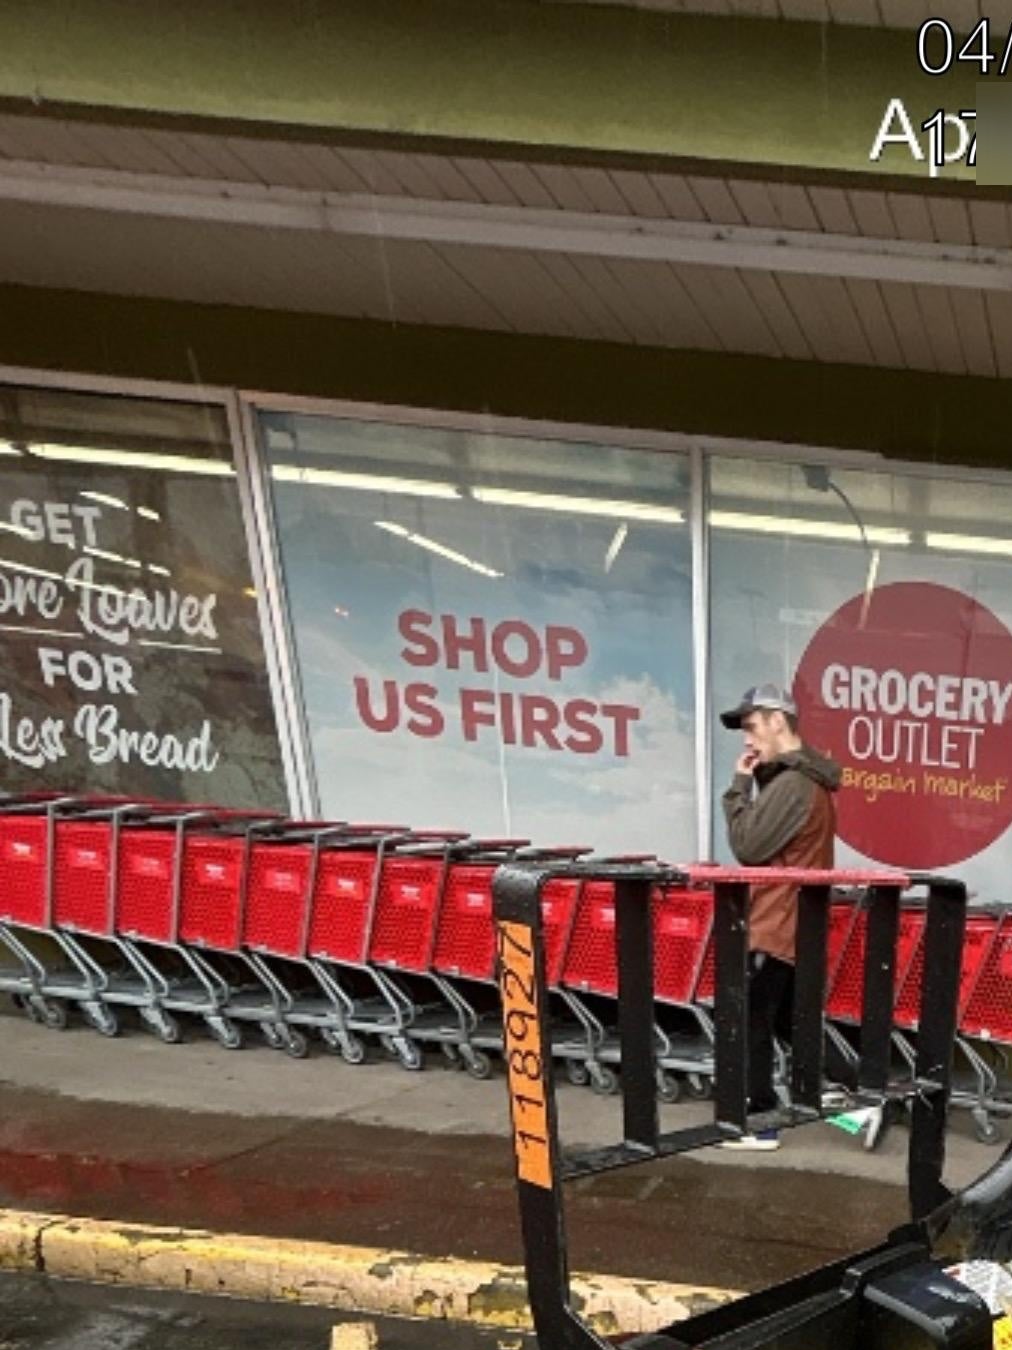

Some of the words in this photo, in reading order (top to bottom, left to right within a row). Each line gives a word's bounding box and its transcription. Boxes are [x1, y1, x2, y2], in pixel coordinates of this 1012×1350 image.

[11, 499, 102, 550] GET
[0, 573, 64, 619] ore
[65, 557, 219, 645] Loaves
[38, 647, 138, 695] FOR
[398, 608, 588, 680] SHOP
[74, 703, 220, 772] Bread
[354, 675, 444, 738] US
[461, 688, 641, 757] FIRST
[848, 716, 984, 770] OUTLET
[841, 765, 916, 802] argain
[500, 926, 546, 1150] 118927
